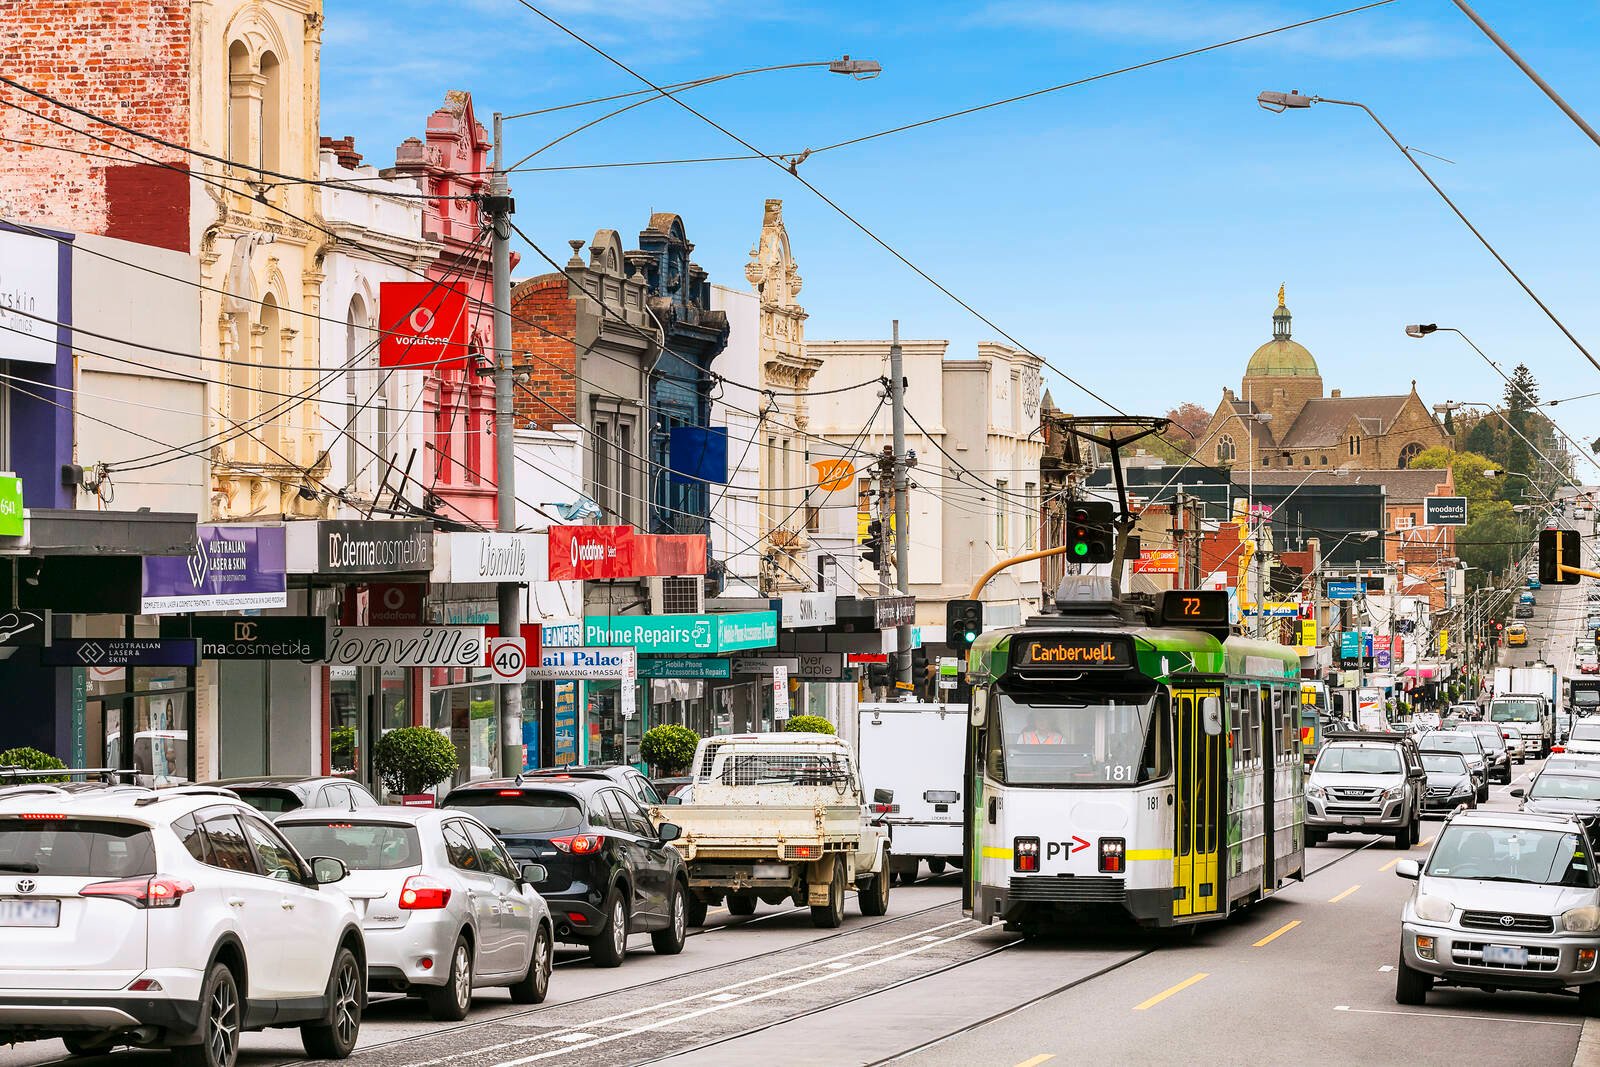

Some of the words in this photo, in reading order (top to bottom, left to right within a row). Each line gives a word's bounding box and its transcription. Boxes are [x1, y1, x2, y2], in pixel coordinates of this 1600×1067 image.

[396, 334, 449, 345] vodafone
[1429, 505, 1464, 513] woodards
[209, 541, 246, 553] AUSTRALIAN
[342, 527, 427, 566] dermacosmetika
[578, 539, 604, 561] vodafone
[209, 558, 228, 570] LASER
[233, 558, 246, 570] SKIN
[479, 537, 527, 577] Lionville
[1183, 598, 1200, 615] 72
[1249, 606, 1264, 615] jut
[372, 611, 416, 620] vodafone
[542, 624, 580, 647] LEANERS
[587, 625, 632, 643] Phone
[635, 625, 690, 646] Repairs
[203, 640, 310, 655] macosmetika
[322, 628, 480, 665] ionville
[1031, 643, 1116, 661] Camberwell
[496, 653, 520, 669] 40
[543, 652, 566, 667] ail
[573, 652, 622, 667] Palac
[665, 660, 684, 668] Mobile
[685, 660, 703, 668] Phone
[530, 669, 552, 677] NAILS
[558, 669, 588, 677] WAXING
[593, 669, 622, 677] MASSAG
[665, 668, 698, 676] Accessories
[705, 668, 727, 677] Repairs
[1104, 766, 1132, 781] 181
[1147, 797, 1159, 810] 181
